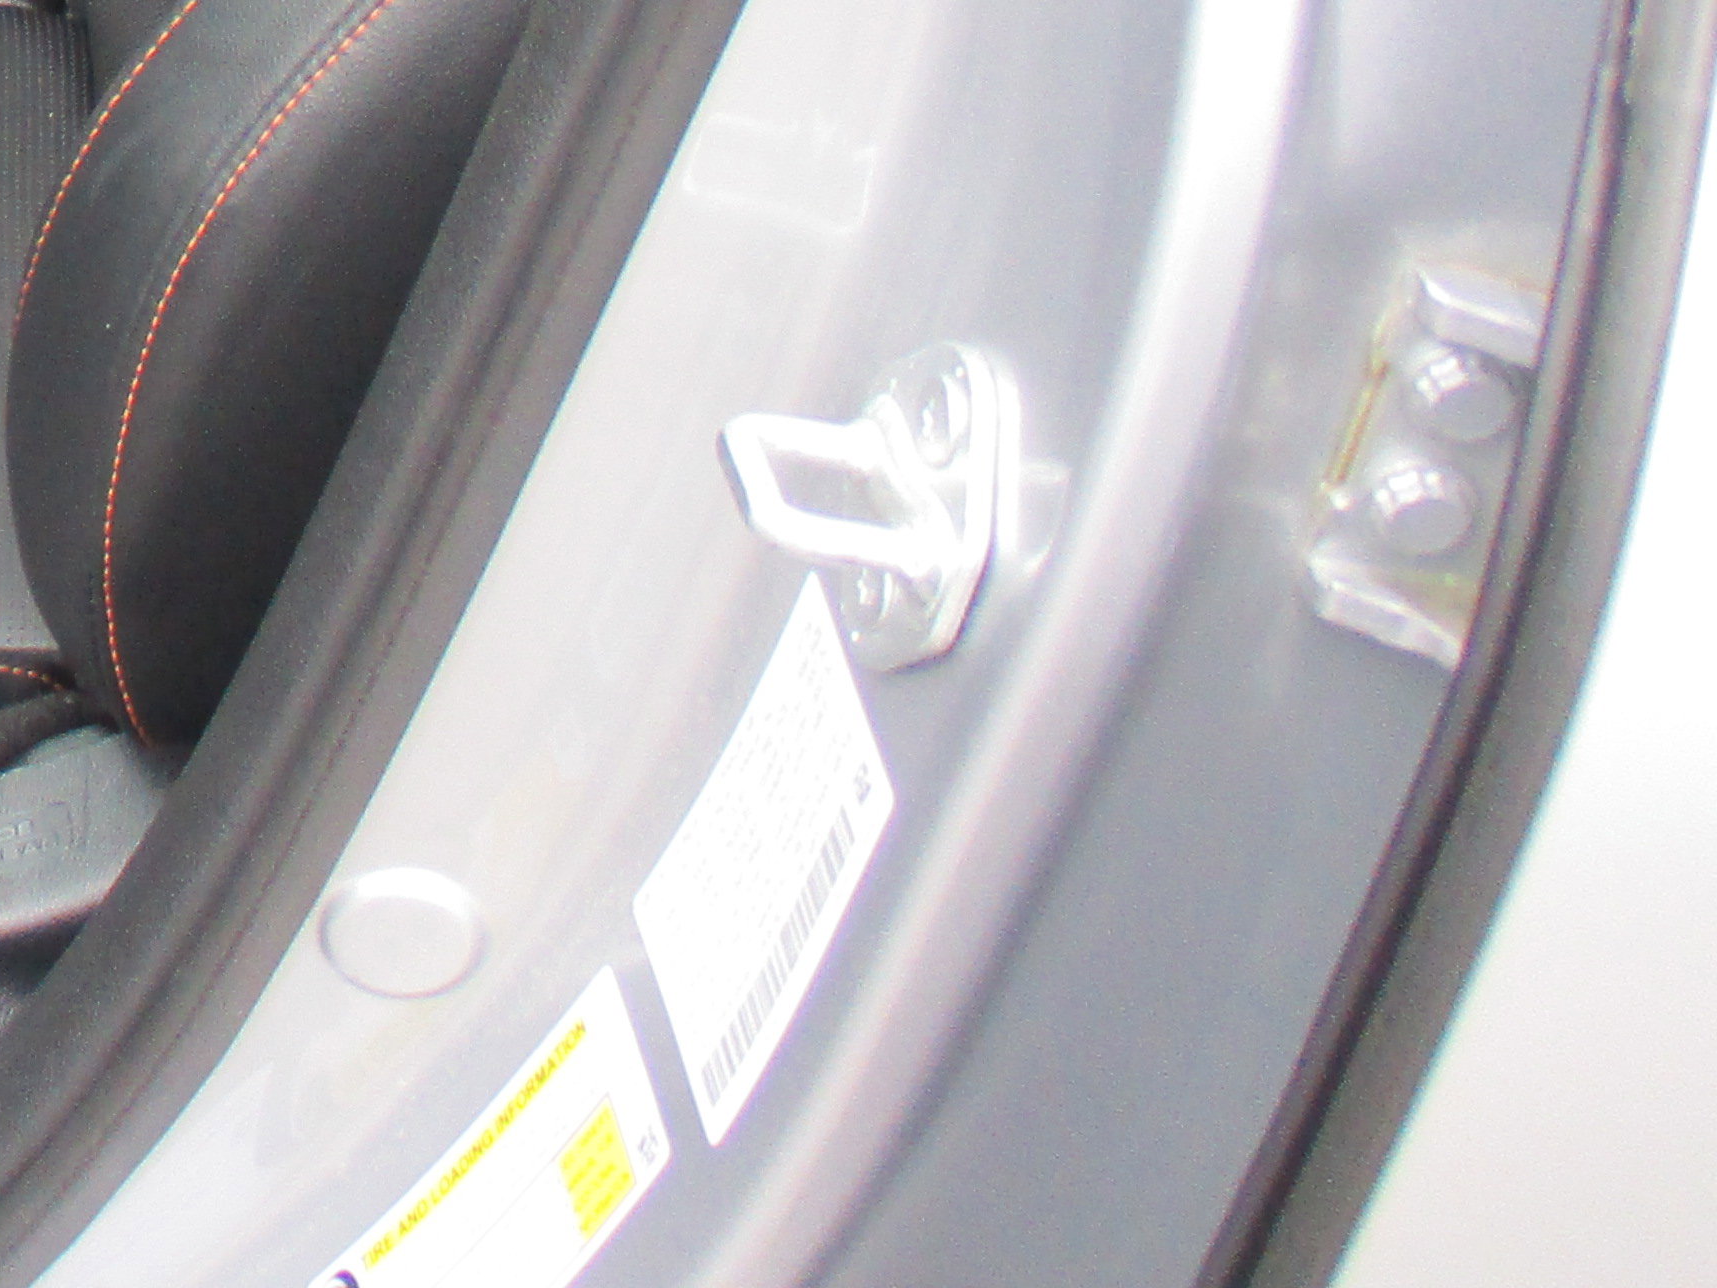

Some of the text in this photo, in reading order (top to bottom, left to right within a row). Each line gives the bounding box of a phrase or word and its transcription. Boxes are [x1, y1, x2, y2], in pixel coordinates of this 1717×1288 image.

[362, 1020, 586, 1271] TIRE AND LOADING INFORMATION
